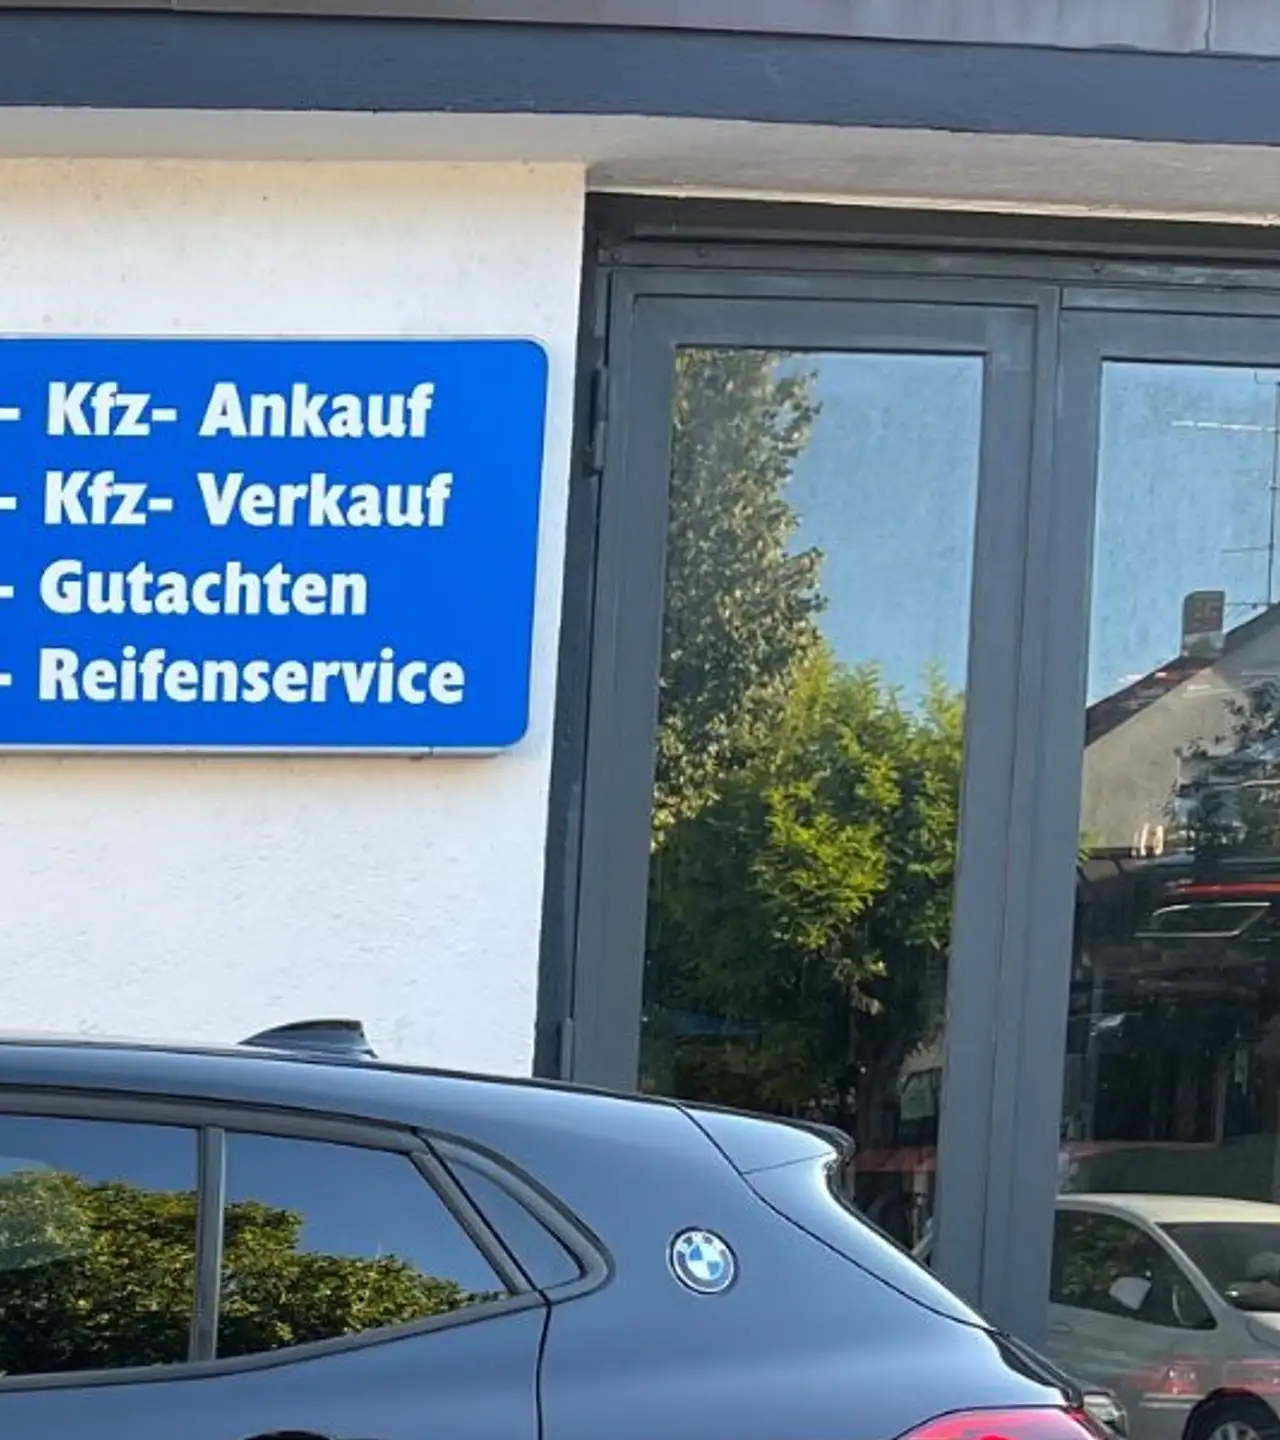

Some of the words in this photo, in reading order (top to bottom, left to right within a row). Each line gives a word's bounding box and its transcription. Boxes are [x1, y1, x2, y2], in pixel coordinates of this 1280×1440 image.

[48, 382, 178, 436] Kfz-
[198, 383, 435, 437] Ankauf
[45, 471, 173, 525] Kfz-
[197, 472, 453, 527] Verkauf
[40, 559, 368, 615] Gutachten
[39, 645, 465, 704] Reifenservice
